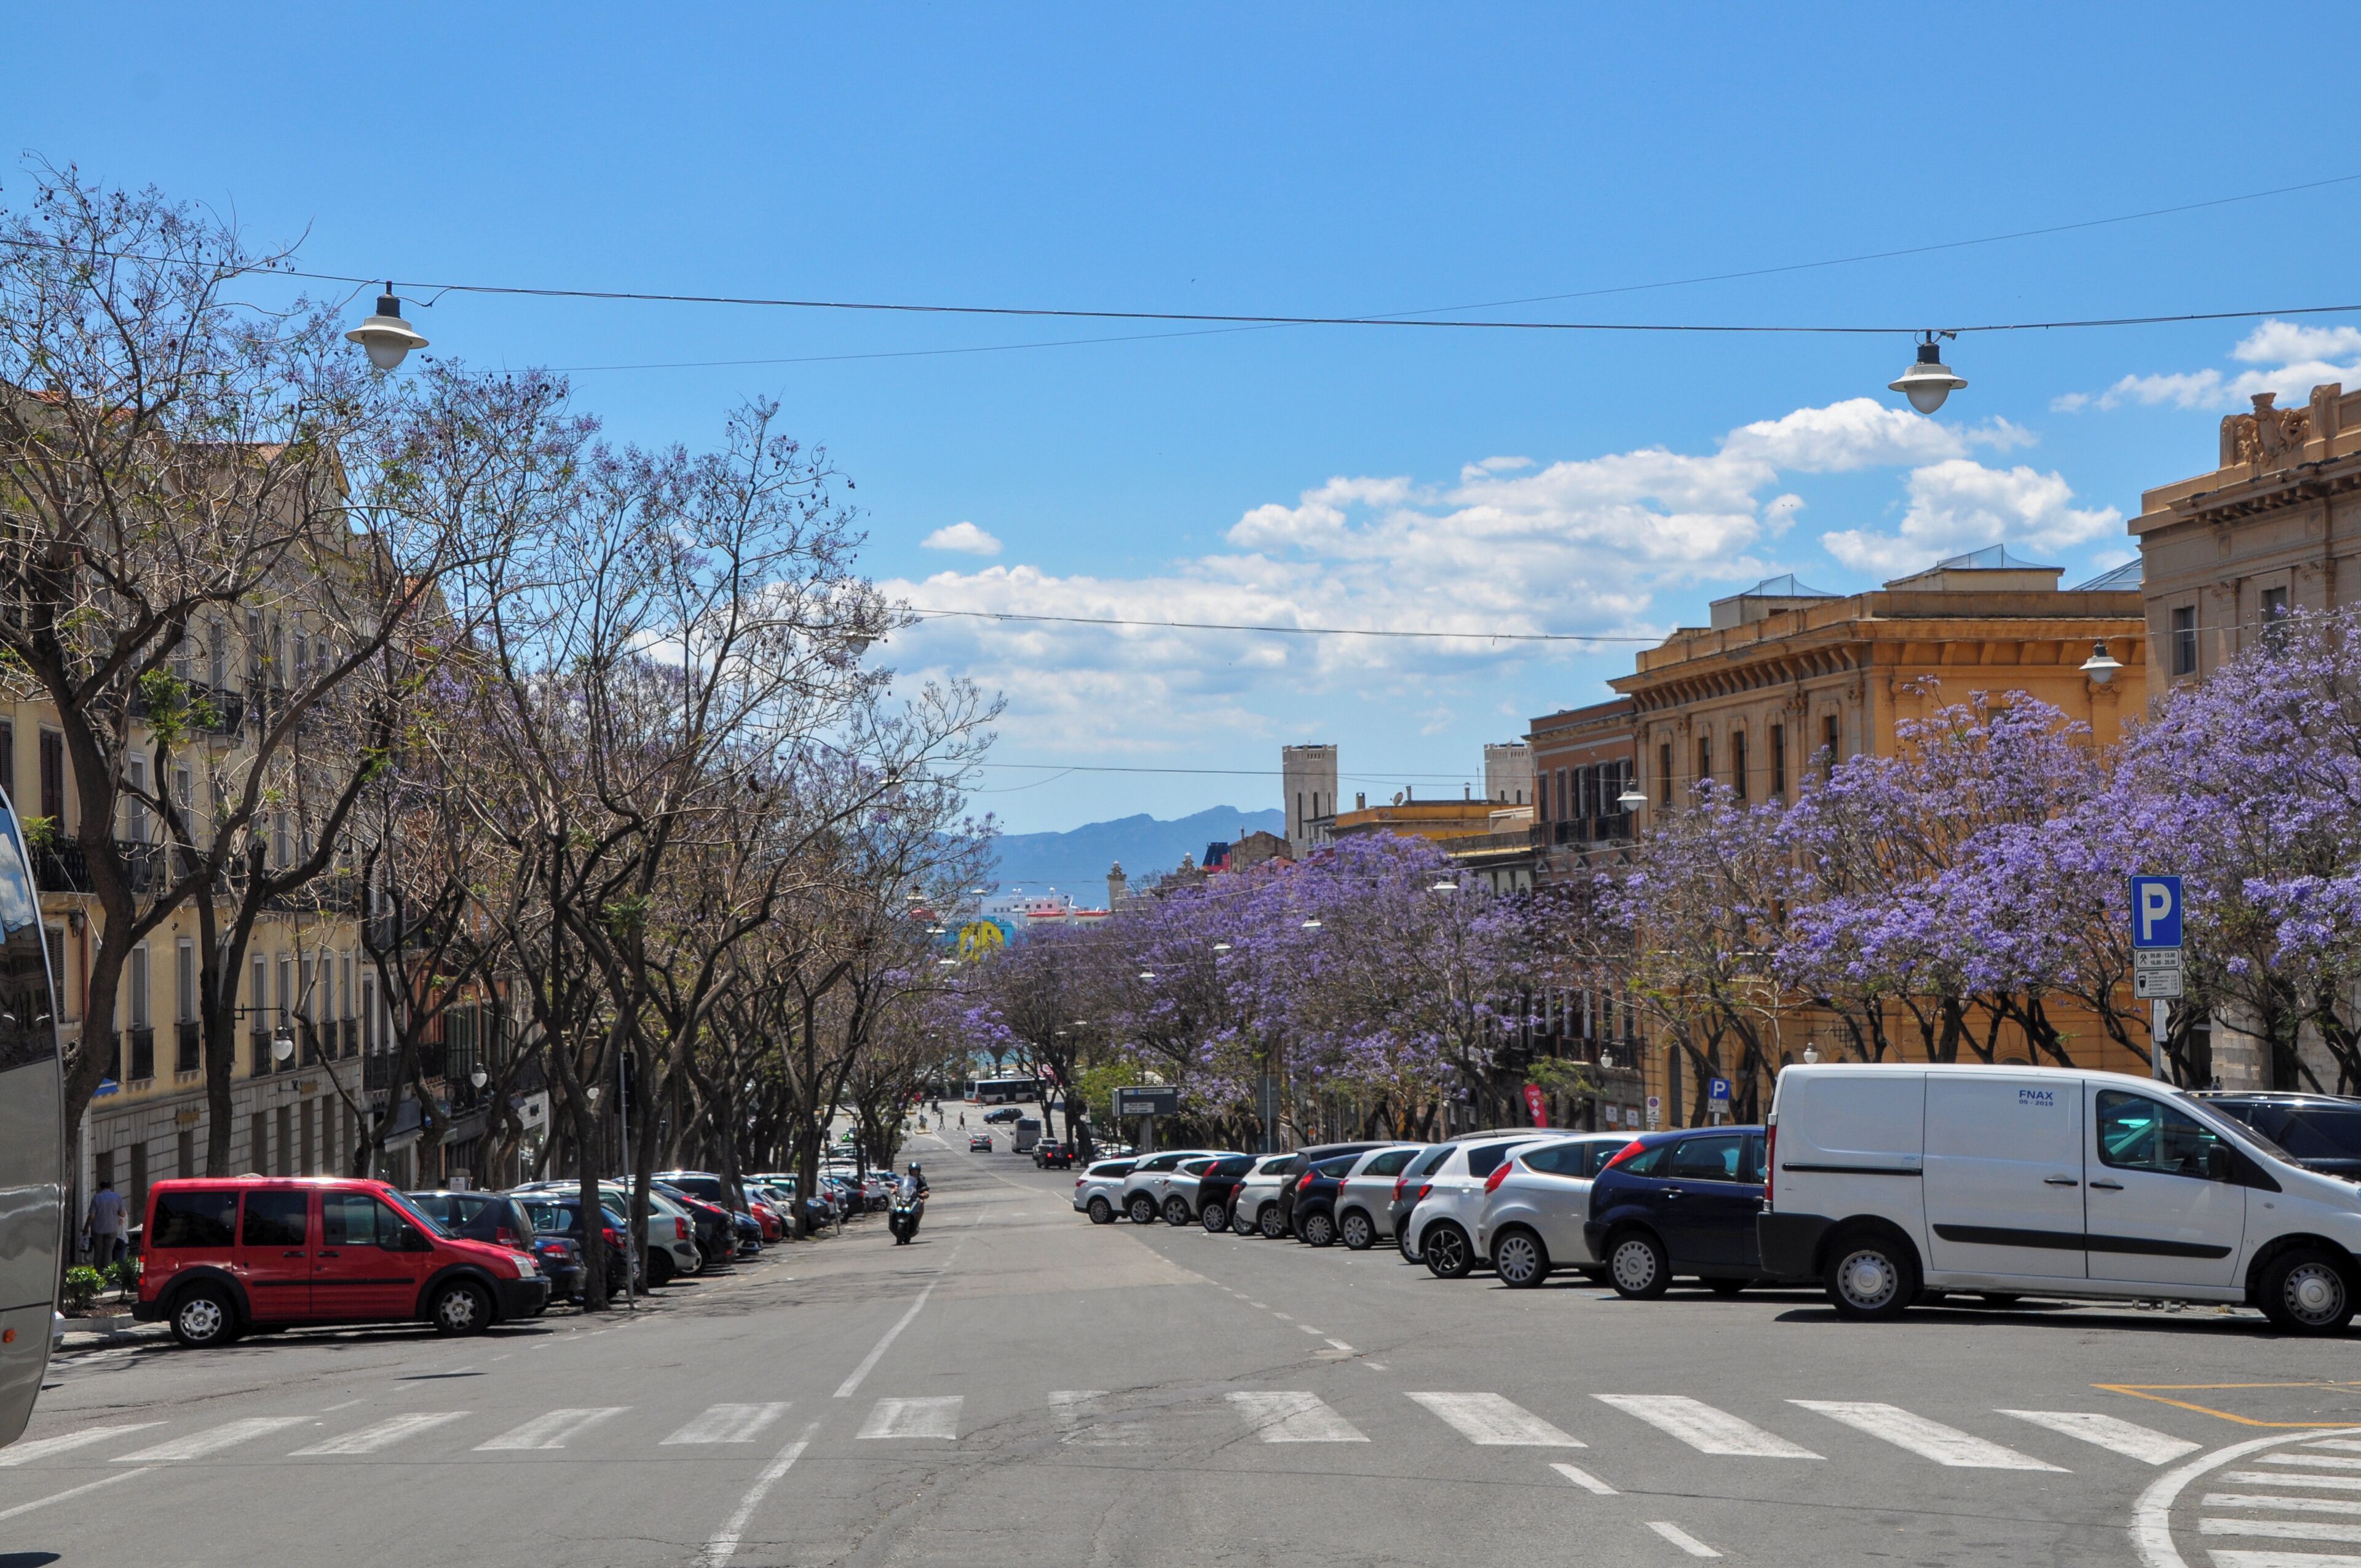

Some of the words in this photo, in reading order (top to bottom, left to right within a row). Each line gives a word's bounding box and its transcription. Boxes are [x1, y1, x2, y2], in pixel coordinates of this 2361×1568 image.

[2142, 883, 2172, 940] P
[1713, 1081, 1726, 1096] P
[2019, 1090, 2053, 1100] FNAX
